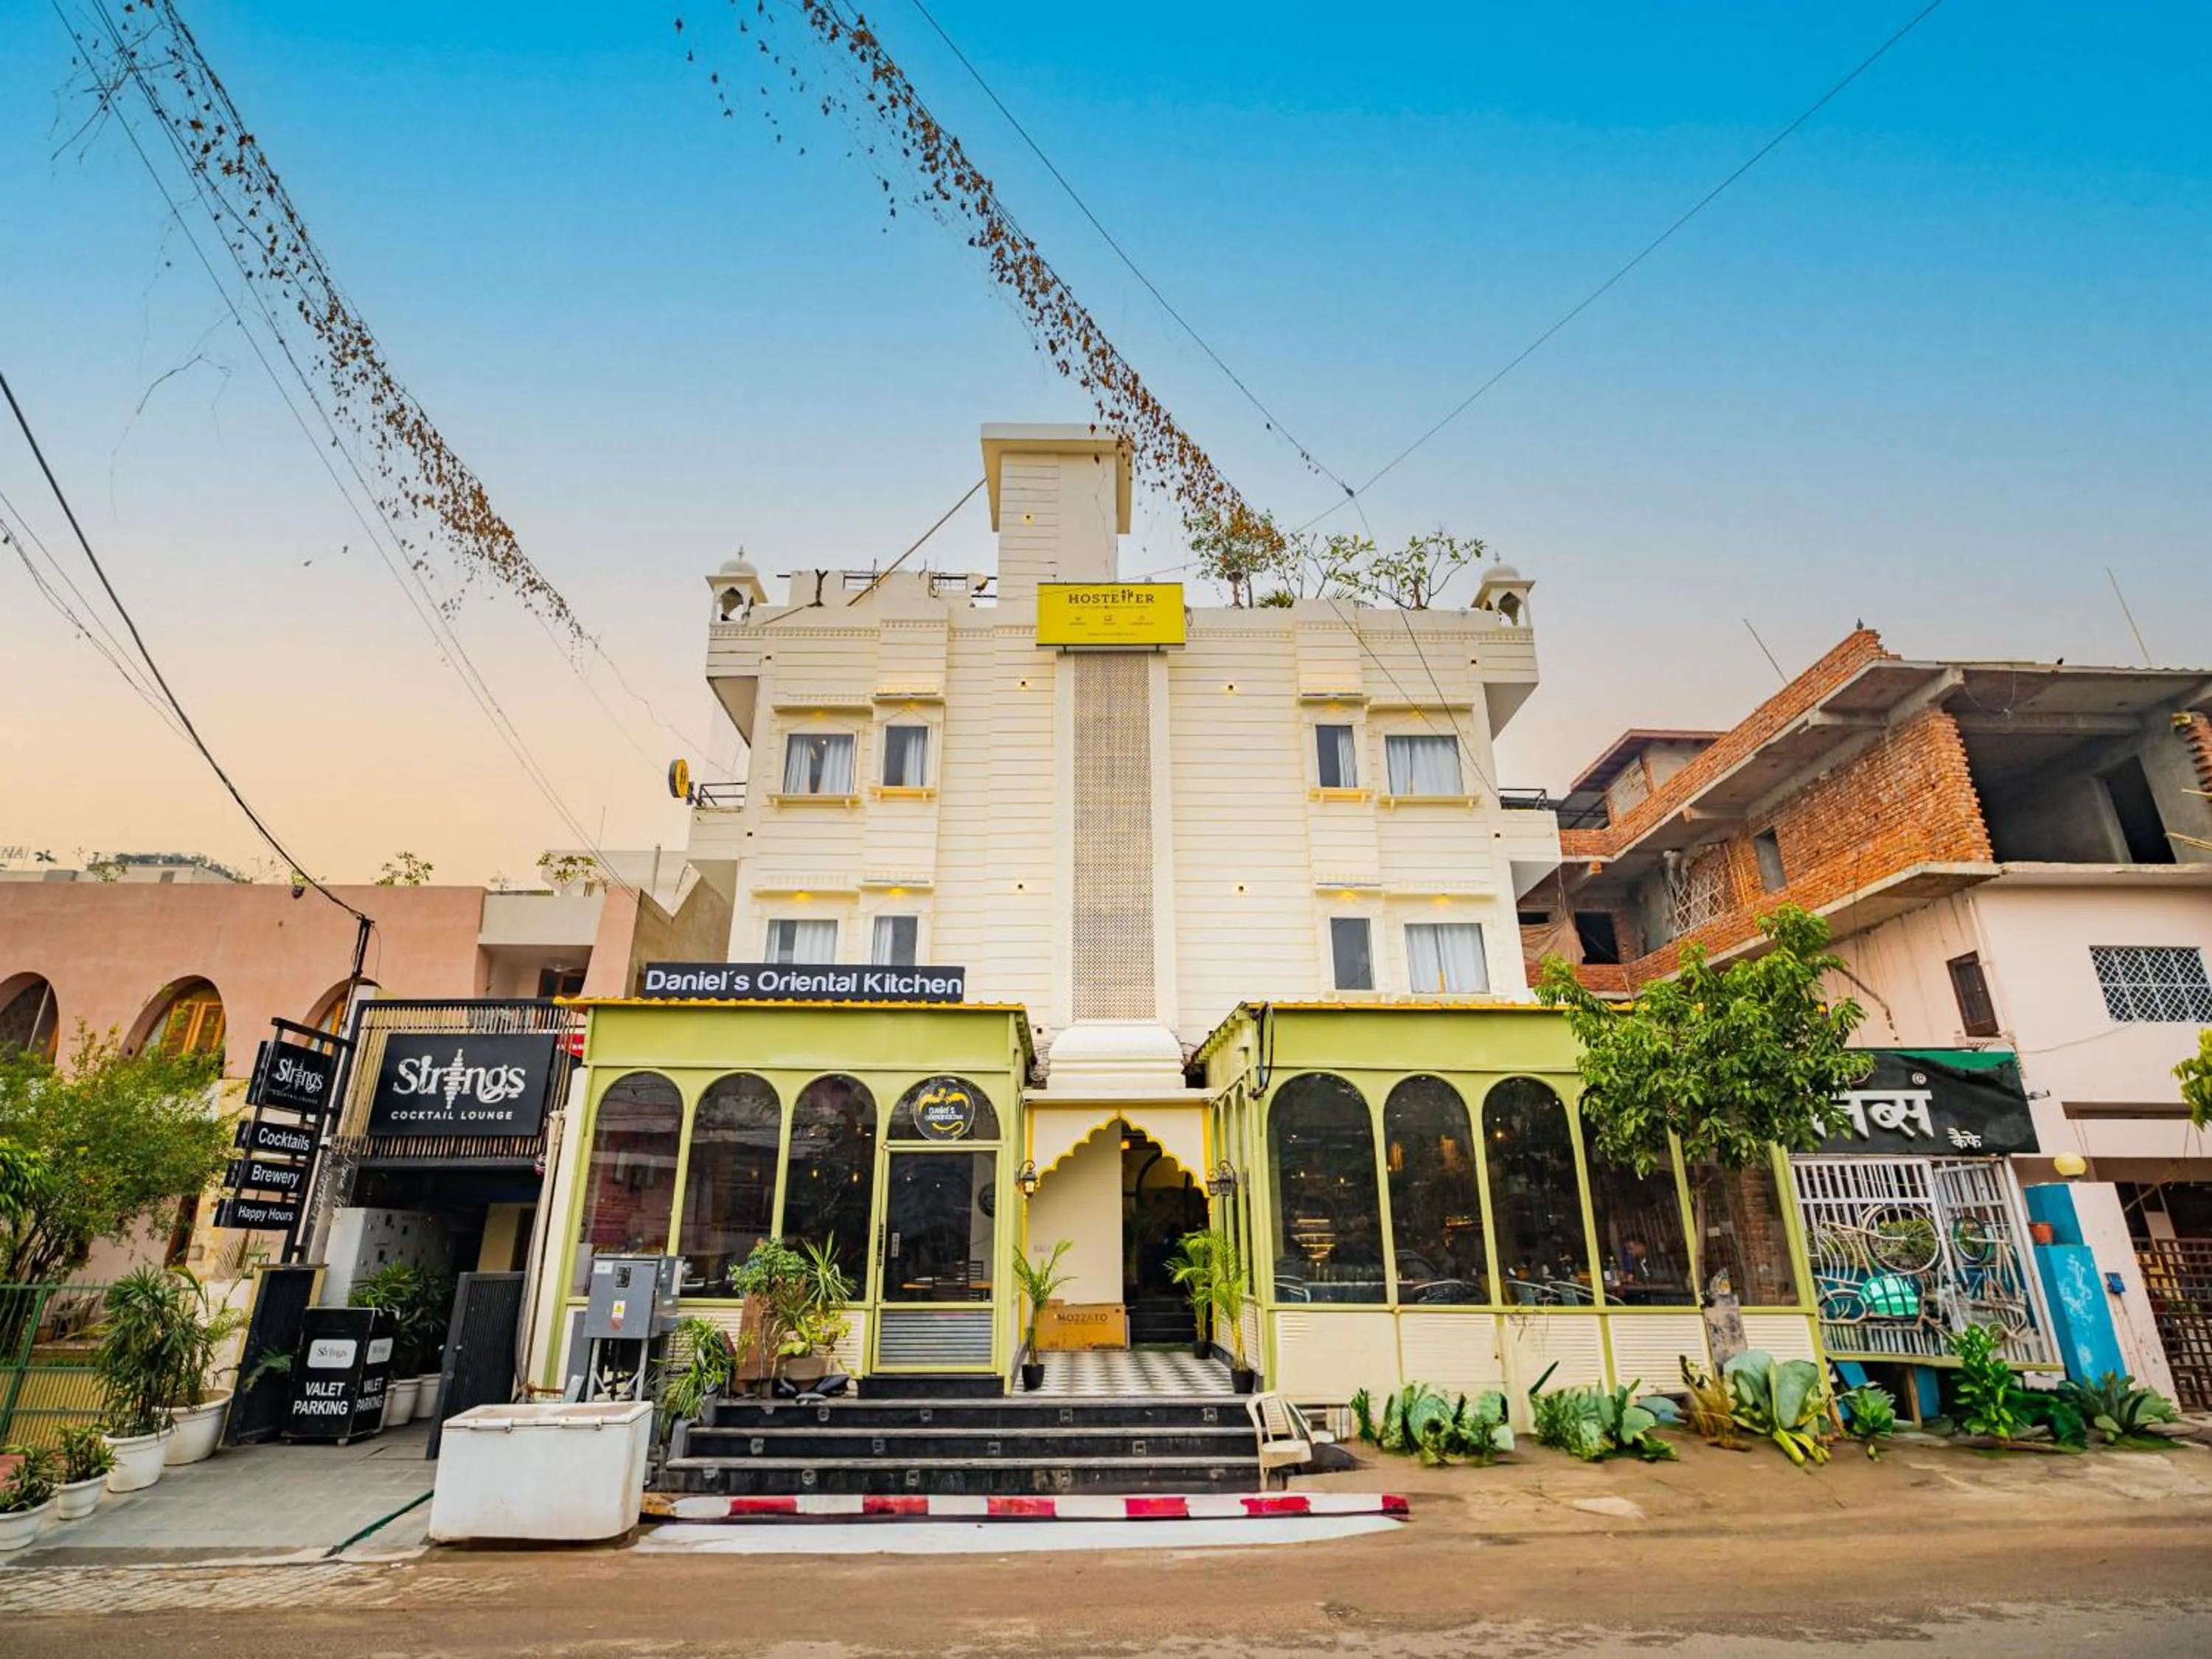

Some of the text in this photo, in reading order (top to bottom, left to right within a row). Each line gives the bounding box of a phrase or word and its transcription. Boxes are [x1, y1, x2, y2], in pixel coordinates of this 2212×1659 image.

[645, 970, 962, 994] Daniel's Oriental Kitchen
[392, 1048, 526, 1110] Strings
[391, 1111, 513, 1120] COCKTAIL LOUNGE
[258, 1127, 310, 1151] Cocktails
[251, 1164, 300, 1189] Brewery
[237, 1206, 293, 1222] Happy Hours
[306, 1381, 345, 1396] VALET
[364, 1377, 383, 1393] VALET
[293, 1400, 349, 1415] PARKING
[355, 1394, 383, 1412] PARKING
